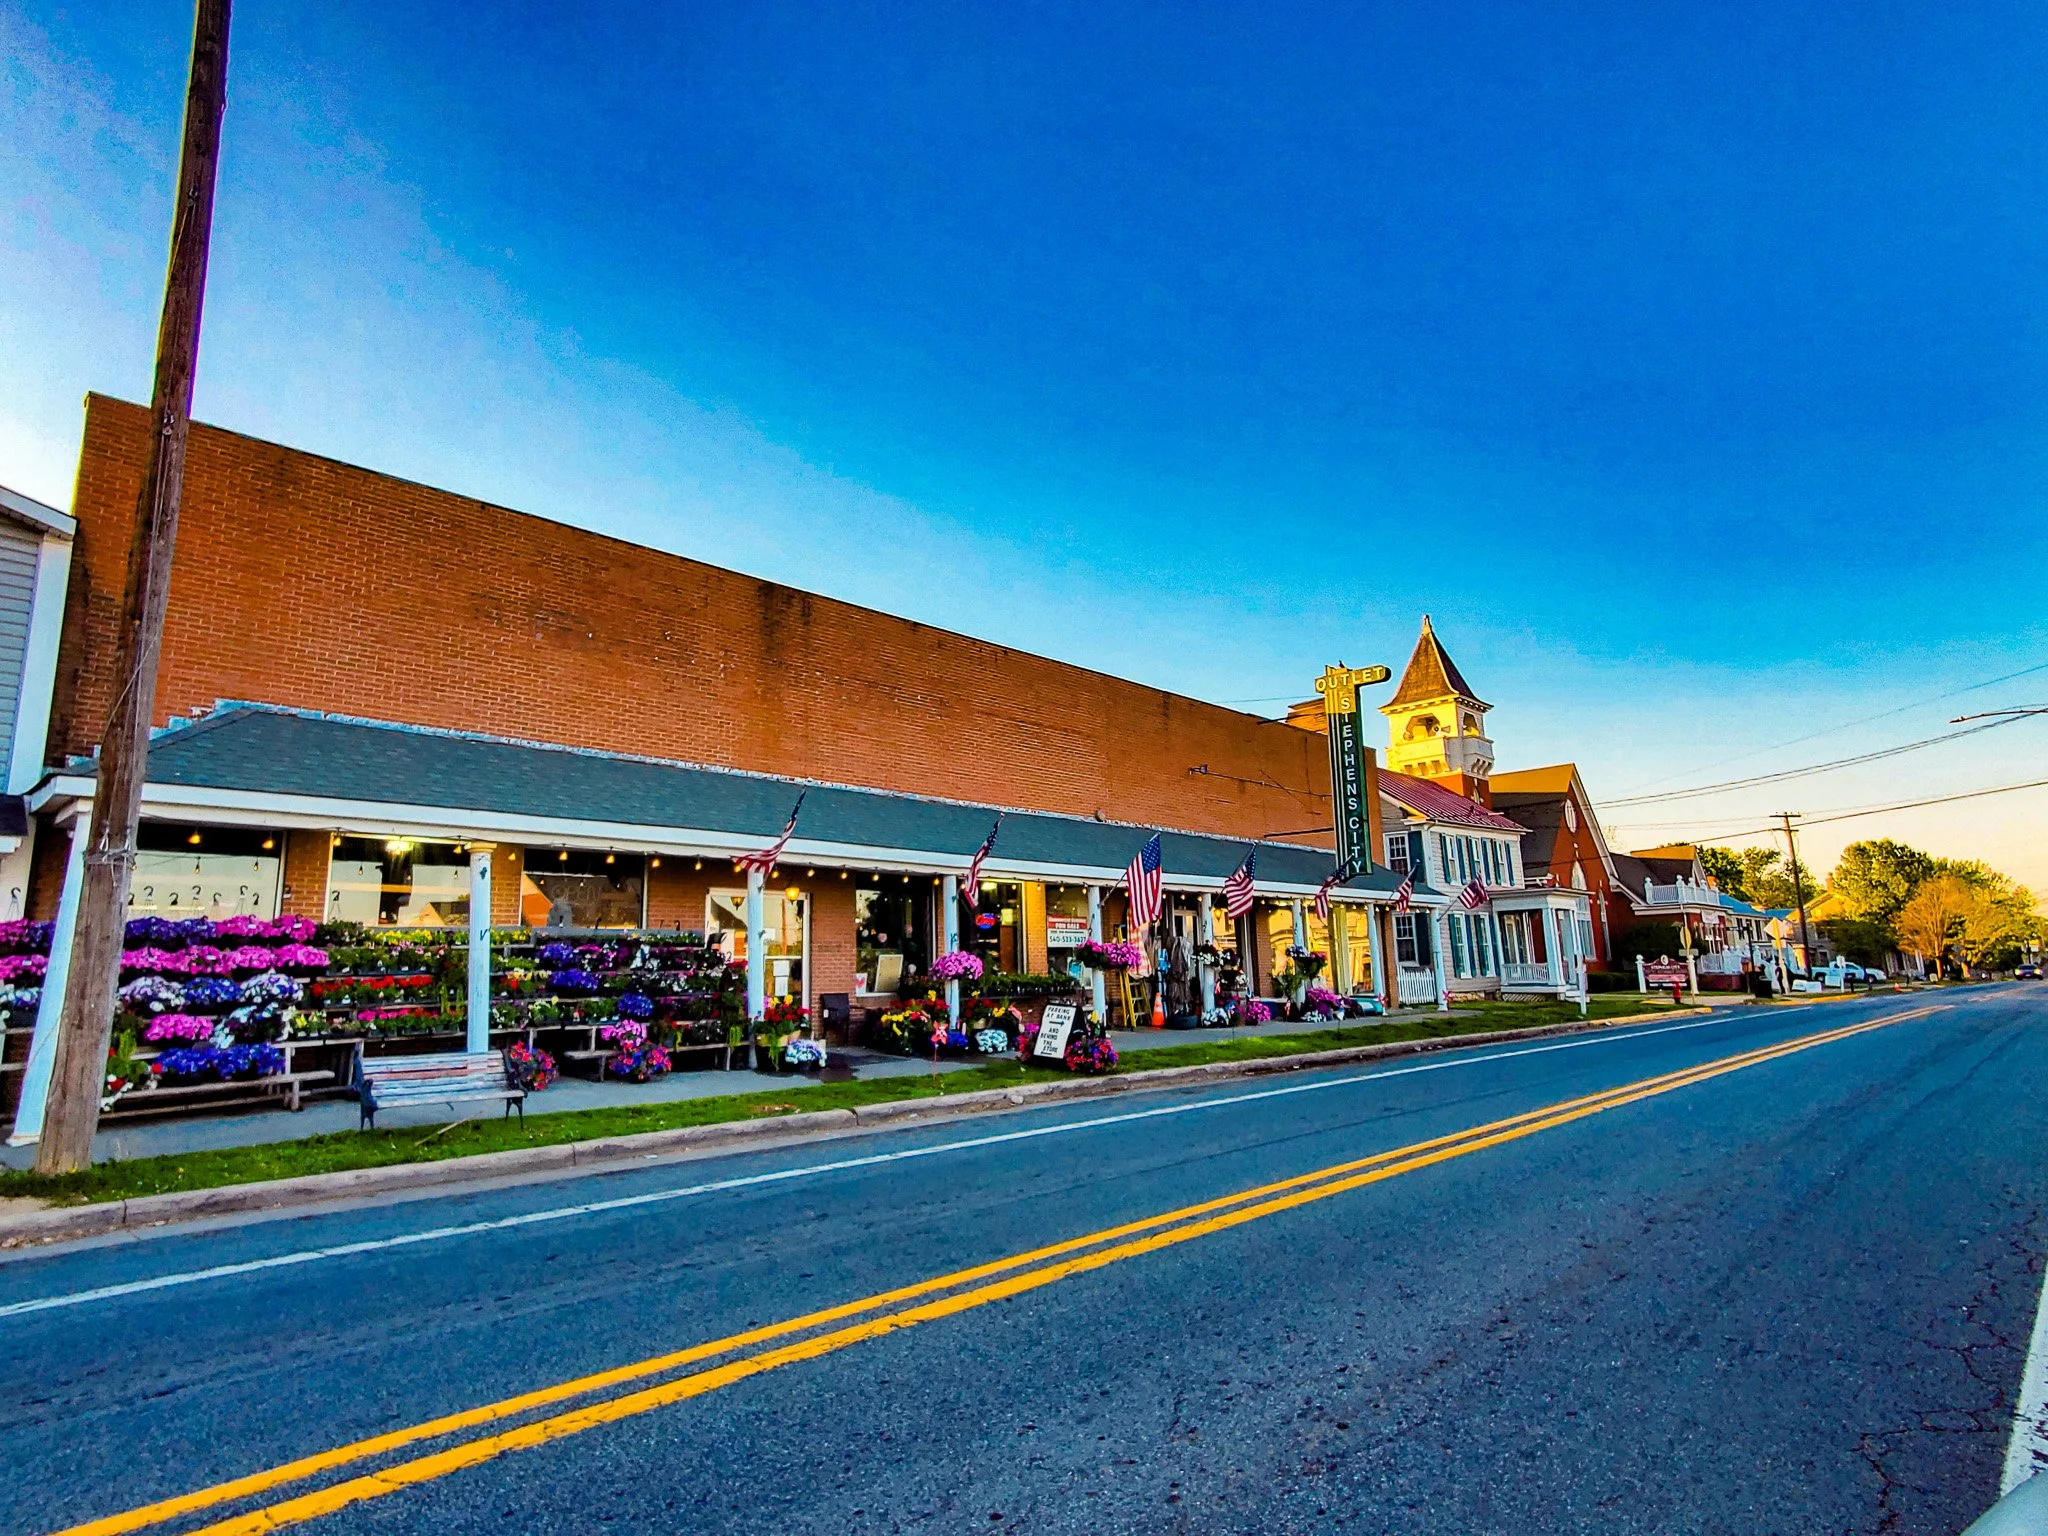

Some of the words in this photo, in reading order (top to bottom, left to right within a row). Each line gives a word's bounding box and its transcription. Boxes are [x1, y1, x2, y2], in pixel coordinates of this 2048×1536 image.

[1316, 666, 1383, 692] OUTLET
[1340, 697, 1358, 810] STEPHENS
[1349, 816, 1362, 874] CITY
[1047, 1006, 1071, 1015] PARKING
[1040, 1032, 1058, 1040] BEHIND
[1042, 1045, 1058, 1053] STORE
